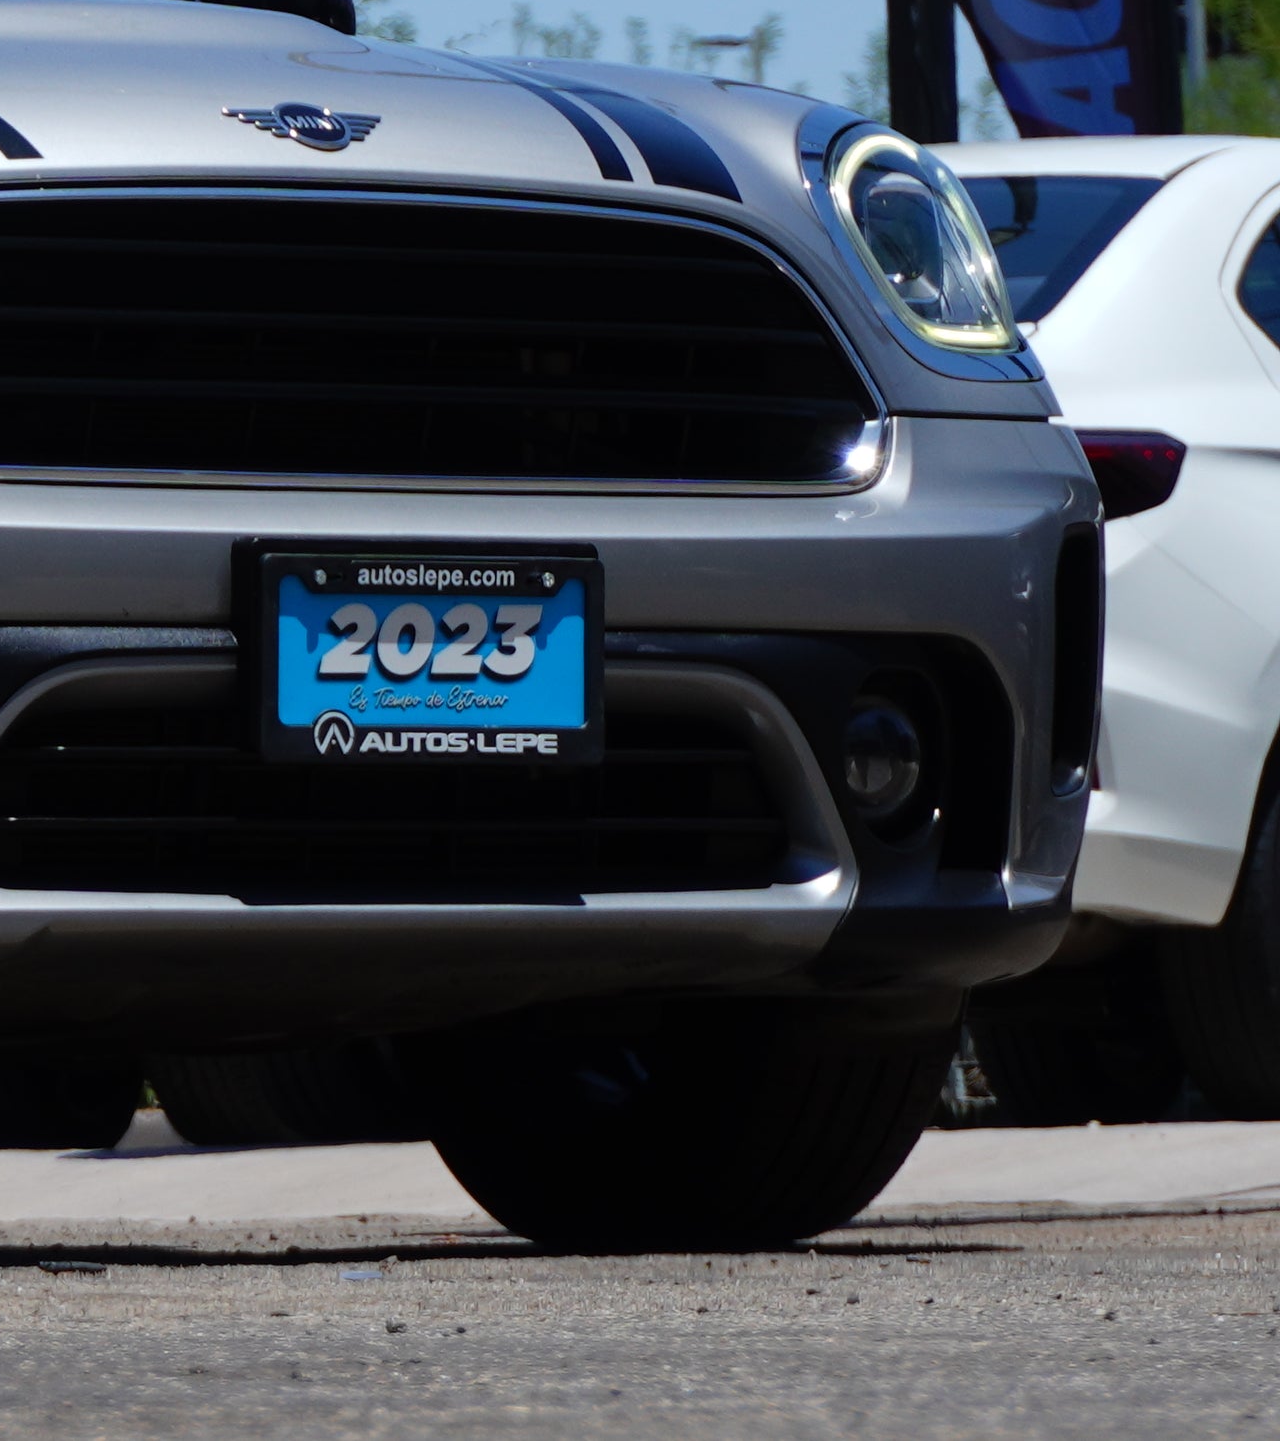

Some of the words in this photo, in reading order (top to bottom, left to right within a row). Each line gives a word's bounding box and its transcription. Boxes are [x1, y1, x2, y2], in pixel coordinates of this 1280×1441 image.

[283, 114, 342, 131] MINI
[356, 564, 516, 589] autoslepe.com
[316, 601, 544, 680] 2023
[350, 685, 368, 711] Es
[374, 686, 422, 711] Tiempo
[425, 690, 444, 708] de
[446, 684, 510, 711] Estrenar
